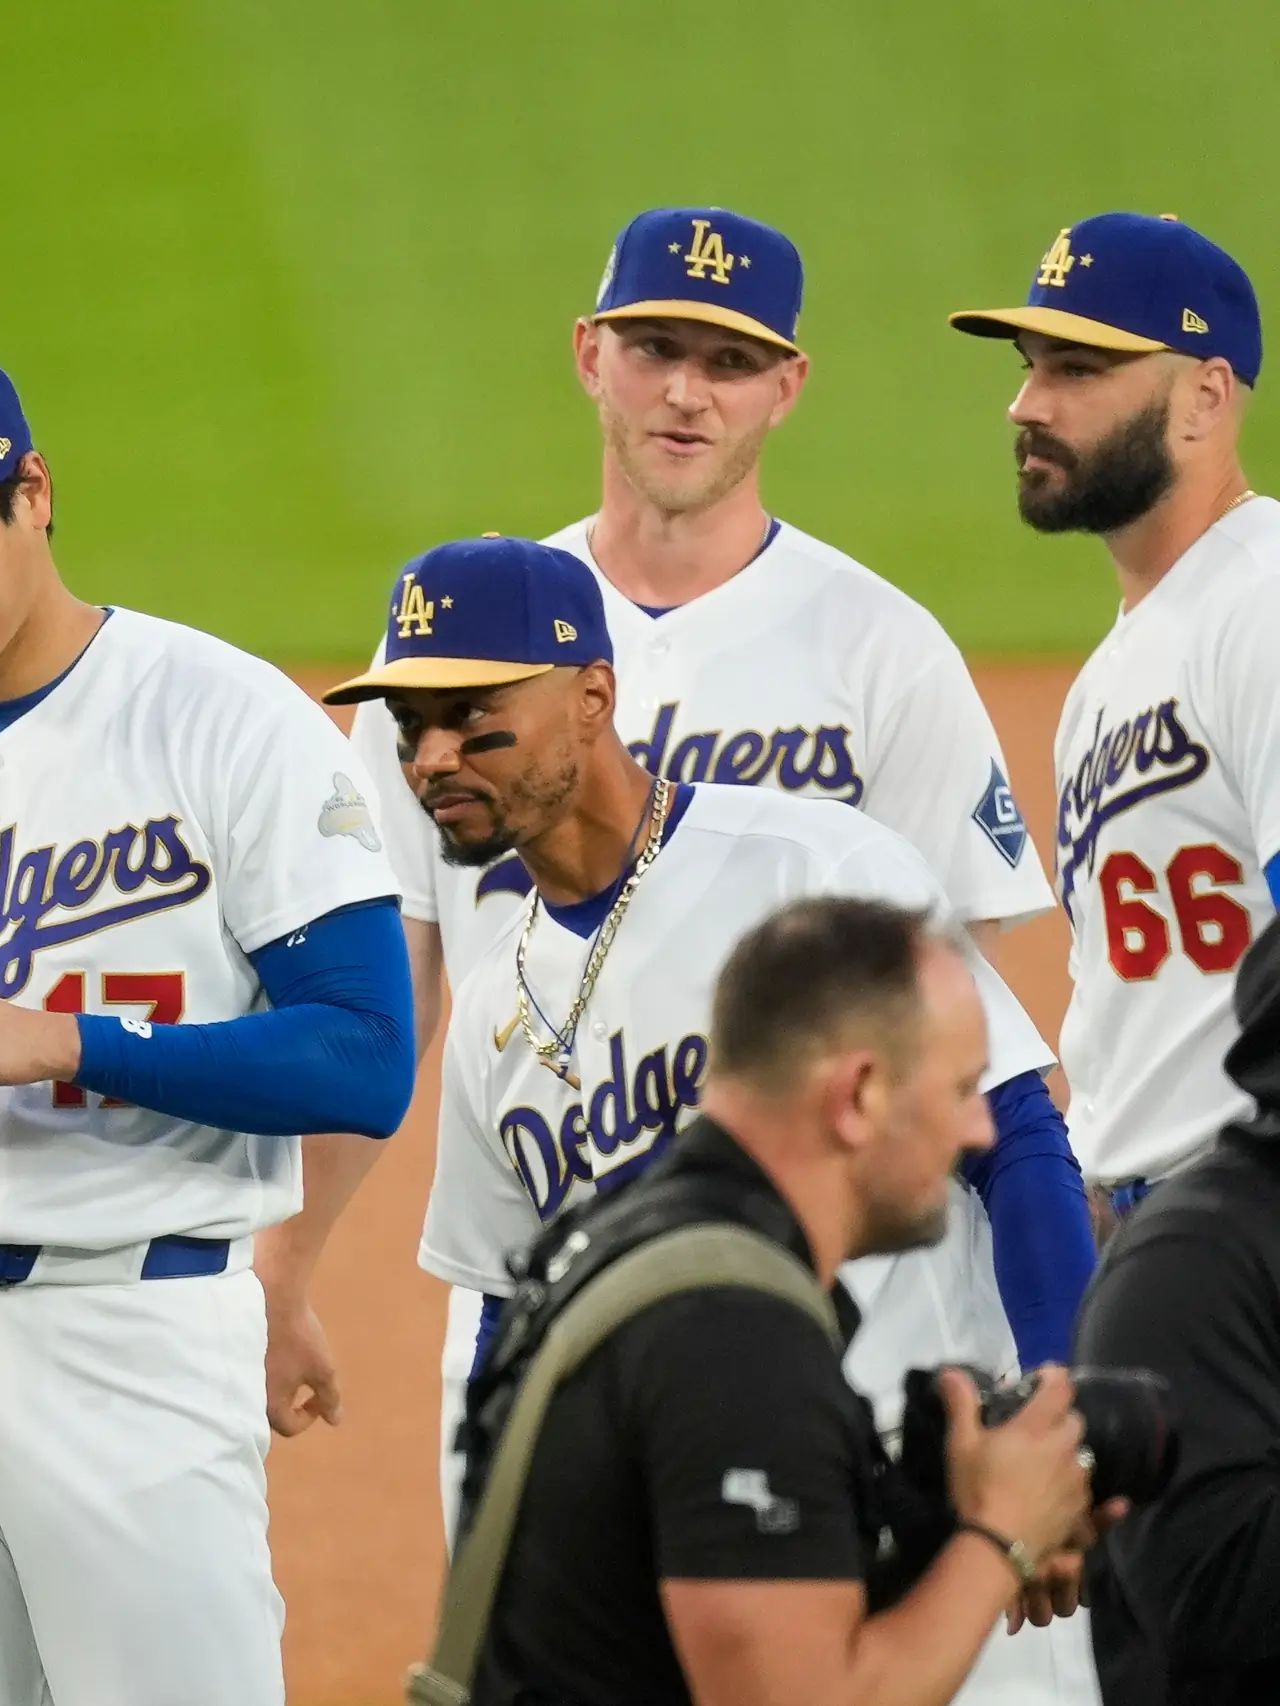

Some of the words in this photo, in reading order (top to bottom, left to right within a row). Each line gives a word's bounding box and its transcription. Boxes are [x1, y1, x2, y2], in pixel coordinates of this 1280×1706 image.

[686, 220, 734, 285] LA
[1036, 227, 1074, 287] LA
[396, 573, 434, 638] LA
[1098, 842, 1252, 982] 66
[500, 1026, 712, 1229] Dodge
